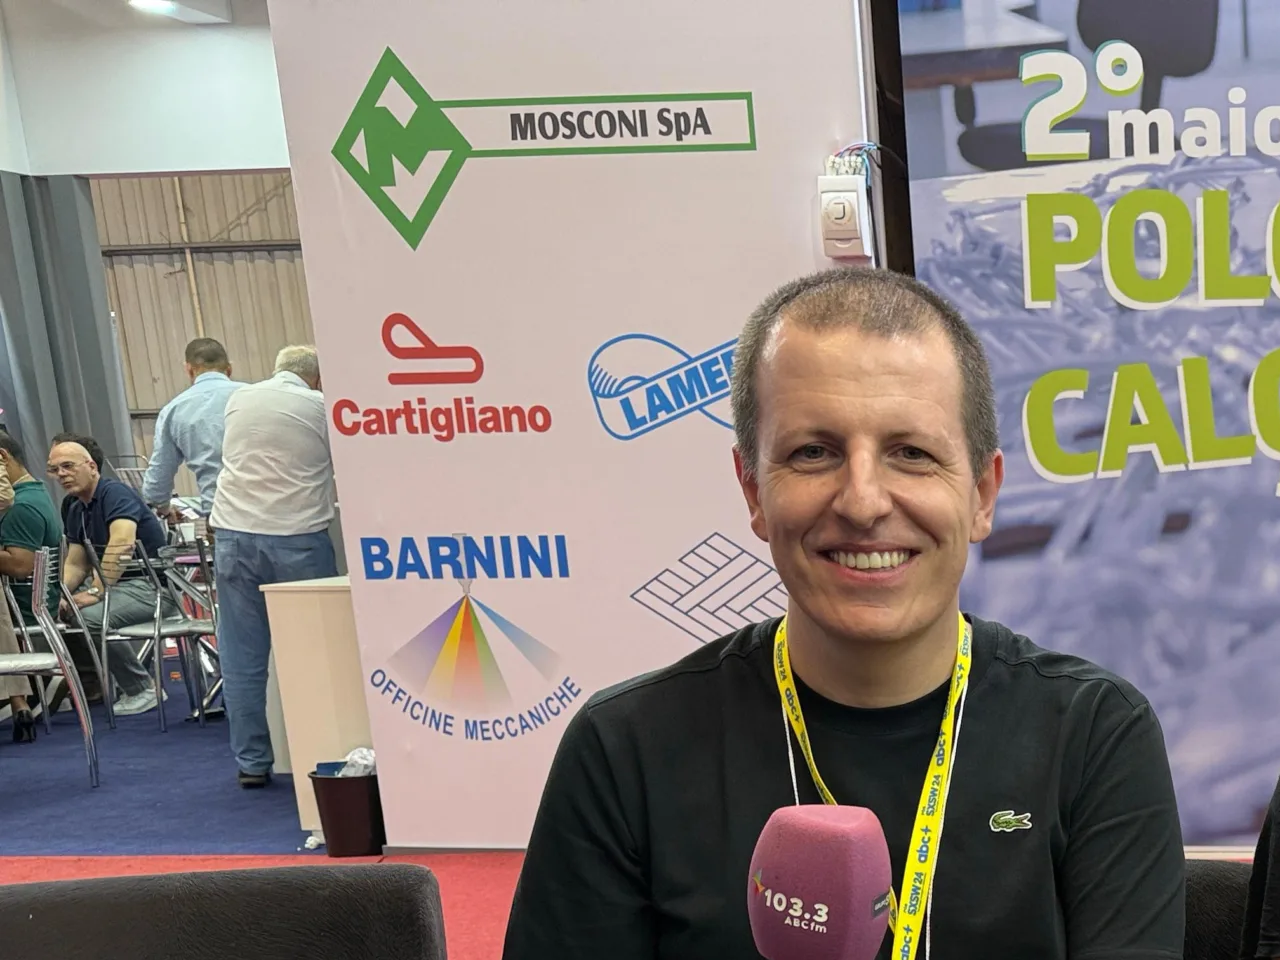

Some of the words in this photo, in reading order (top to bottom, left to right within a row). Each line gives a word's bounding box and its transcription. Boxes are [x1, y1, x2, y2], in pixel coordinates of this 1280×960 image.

[509, 109, 648, 141] MOSCONI
[657, 107, 712, 141] SpA
[332, 398, 552, 443] Cartigliano
[360, 534, 570, 581] BARNINI
[370, 667, 455, 737] OFFICINE
[464, 676, 583, 742] MECCANICHE
[926, 786, 938, 817] SXSW
[916, 825, 932, 863] abc+
[914, 871, 925, 885] 24
[765, 888, 829, 922] 103.3
[908, 884, 922, 916] SXSW
[784, 916, 827, 934] ABCfm
